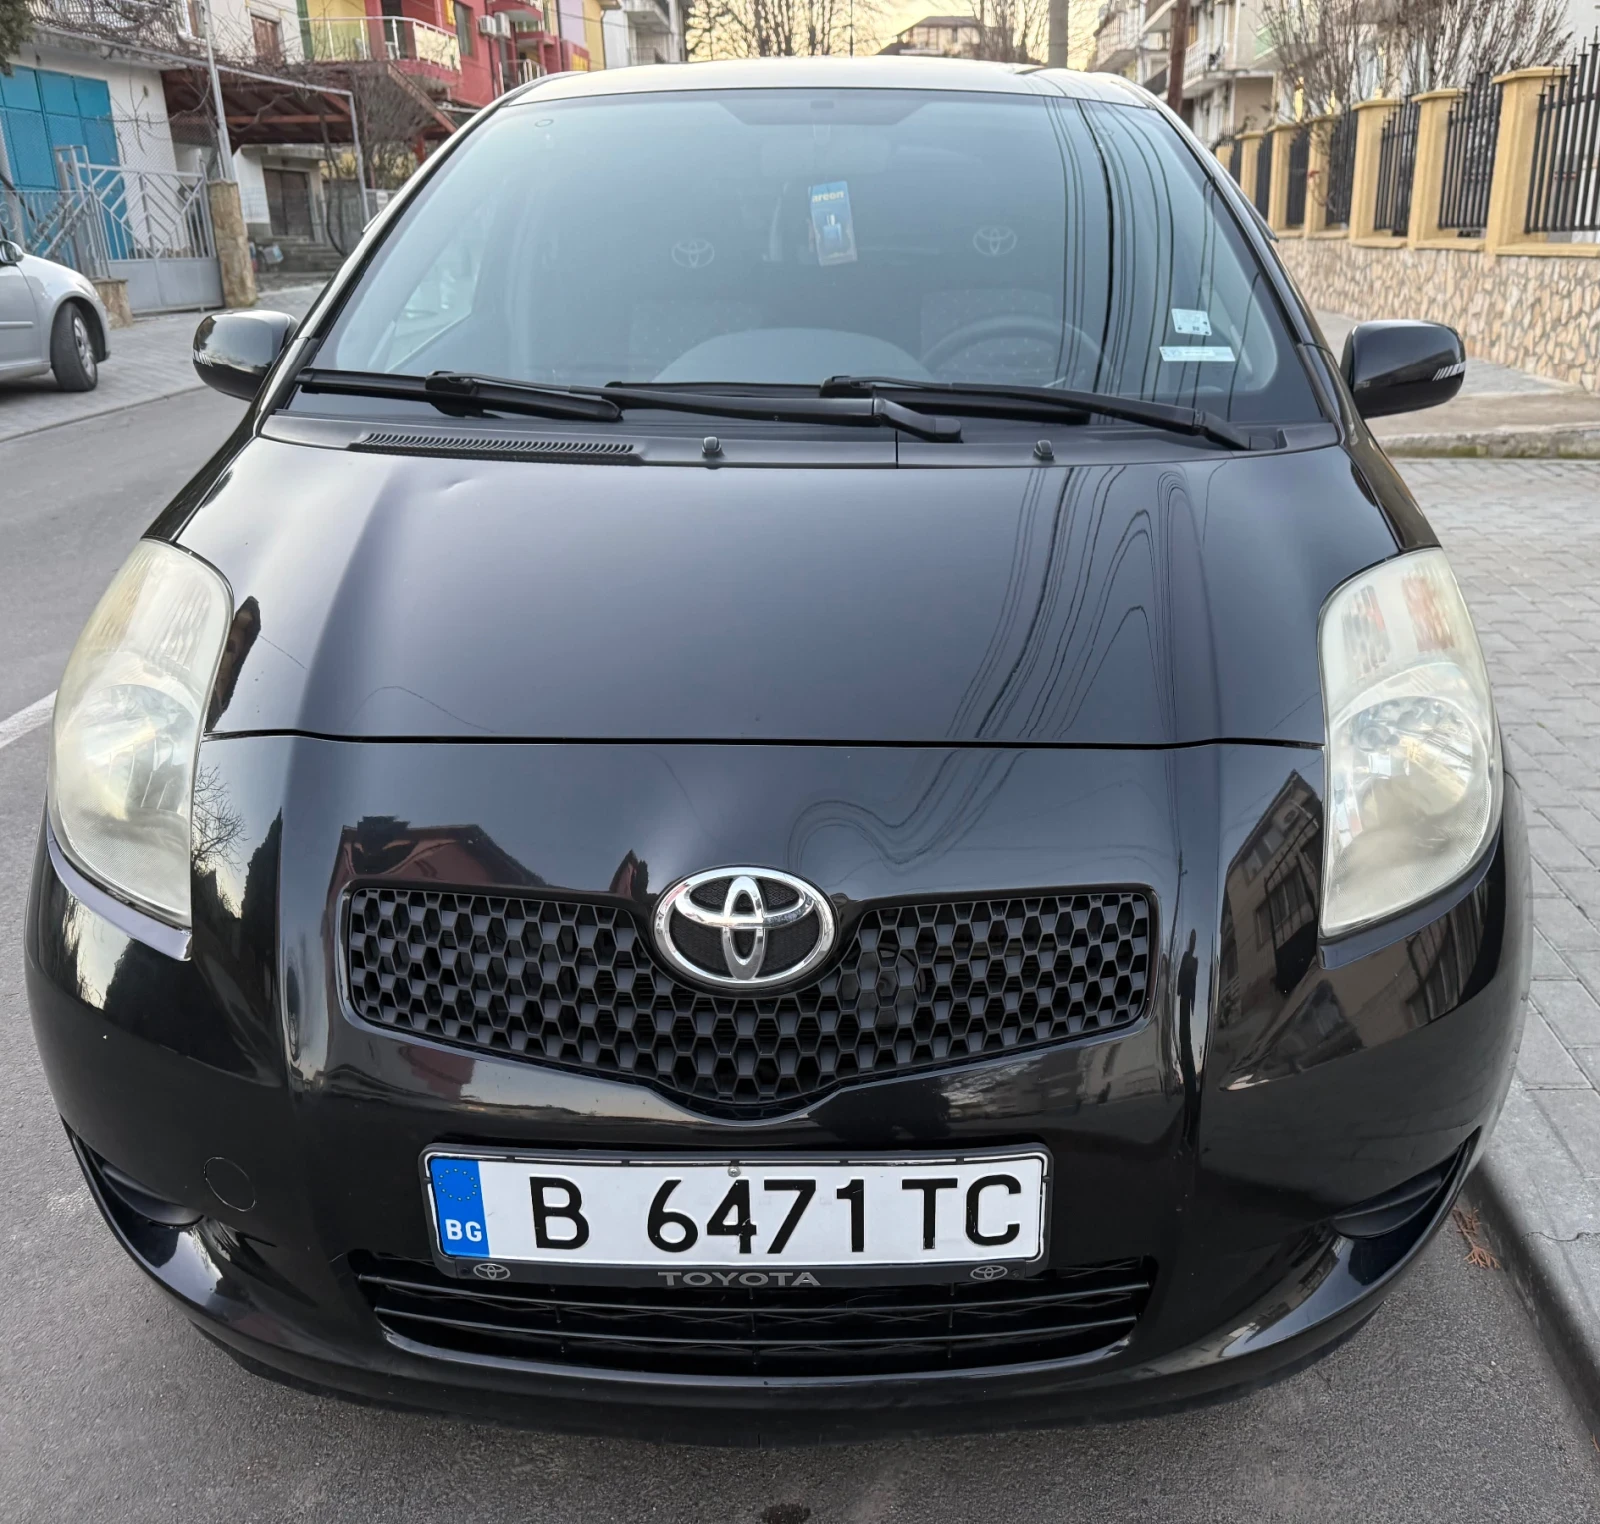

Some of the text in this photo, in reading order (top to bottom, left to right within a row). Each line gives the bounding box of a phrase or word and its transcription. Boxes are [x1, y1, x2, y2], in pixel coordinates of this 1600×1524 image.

[811, 190, 844, 203] areon
[529, 1174, 1021, 1254] B 6471 TC
[445, 1218, 482, 1242] BG
[657, 1271, 821, 1287] TOYOTA
